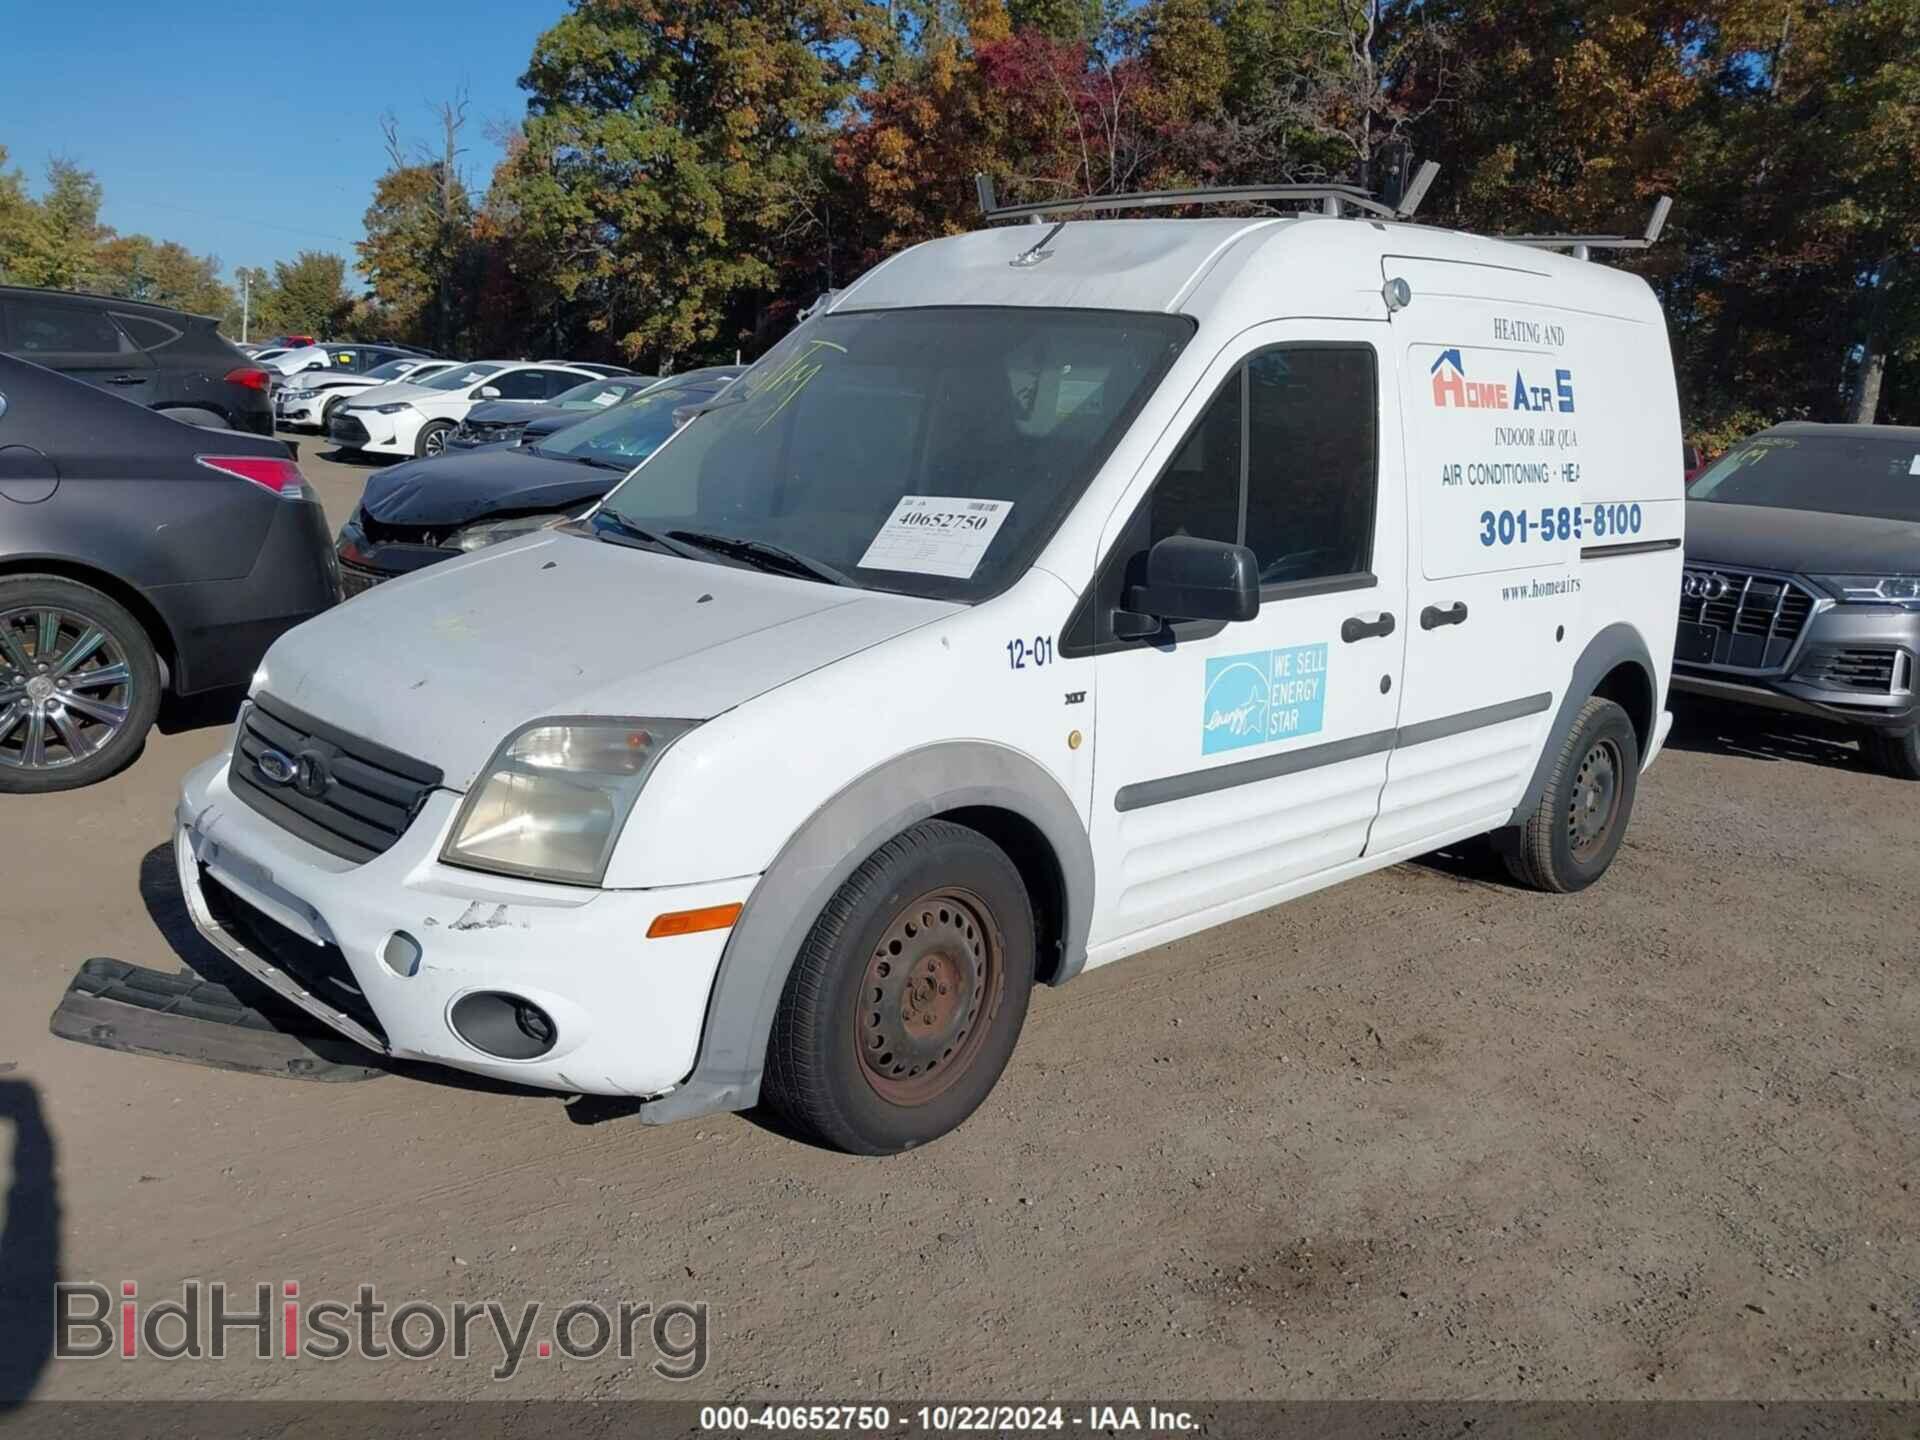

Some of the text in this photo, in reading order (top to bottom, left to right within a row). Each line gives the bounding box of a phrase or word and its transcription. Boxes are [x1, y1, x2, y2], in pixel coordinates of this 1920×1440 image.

[1494, 317, 1565, 346] HEATING AND
[1432, 366, 1575, 413] HOME AIR S
[1495, 427, 1535, 447] INDOOR
[1538, 428, 1555, 447] AIR
[1442, 463, 1463, 486] AIR
[1467, 462, 1549, 486] CONDITIONING
[899, 511, 988, 530] 40652750
[1480, 503, 1642, 547] 301-585-8100
[1502, 574, 1581, 601] www.homeairs
[1006, 635, 1052, 669] 12-01
[1274, 650, 1326, 677] WE SELL
[1272, 678, 1320, 706] ENERGY
[1270, 708, 1300, 735] STAR
